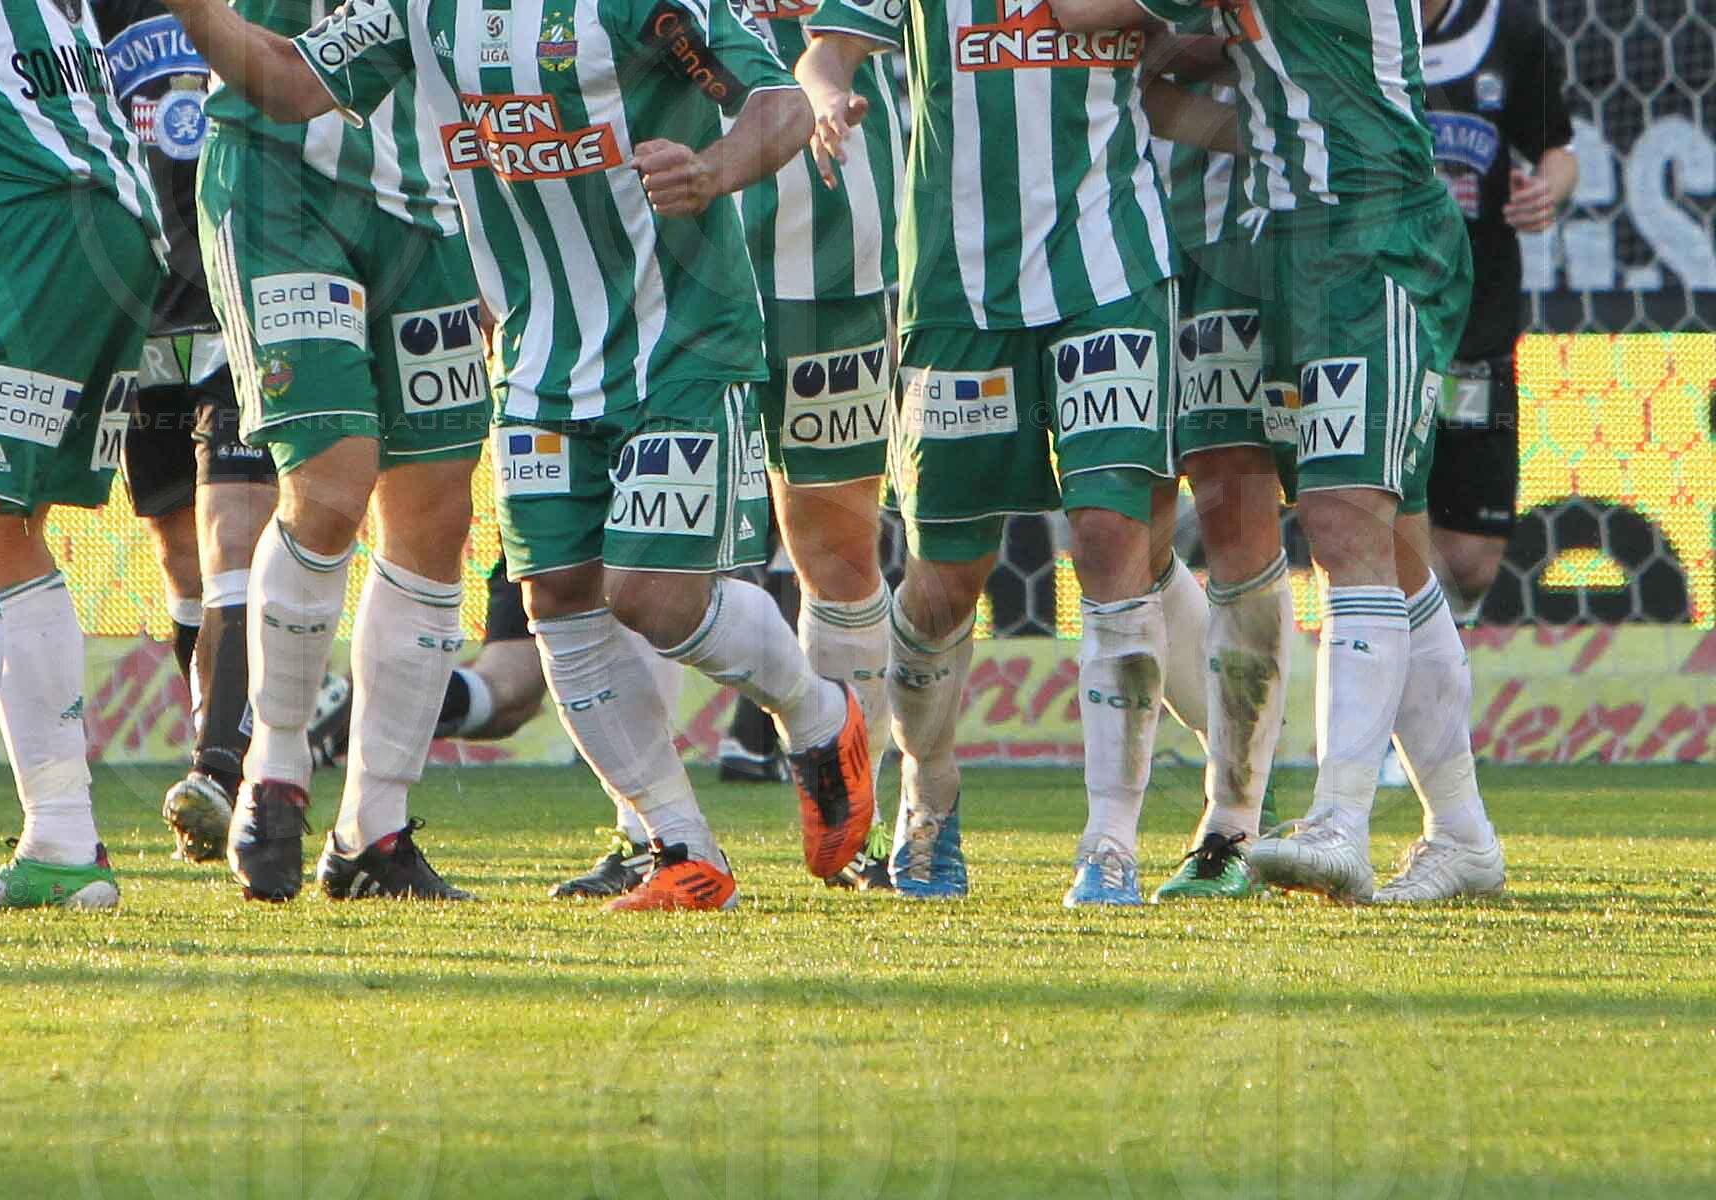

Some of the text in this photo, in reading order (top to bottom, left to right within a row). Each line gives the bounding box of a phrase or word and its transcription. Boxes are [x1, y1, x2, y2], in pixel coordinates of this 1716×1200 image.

[318, 12, 393, 68] OMV
[480, 50, 510, 62] LIGA
[462, 101, 557, 134] WIEN
[259, 282, 315, 305] card
[789, 399, 889, 444] OMV
[1060, 386, 1154, 432] OMV
[566, 688, 619, 713] CR
